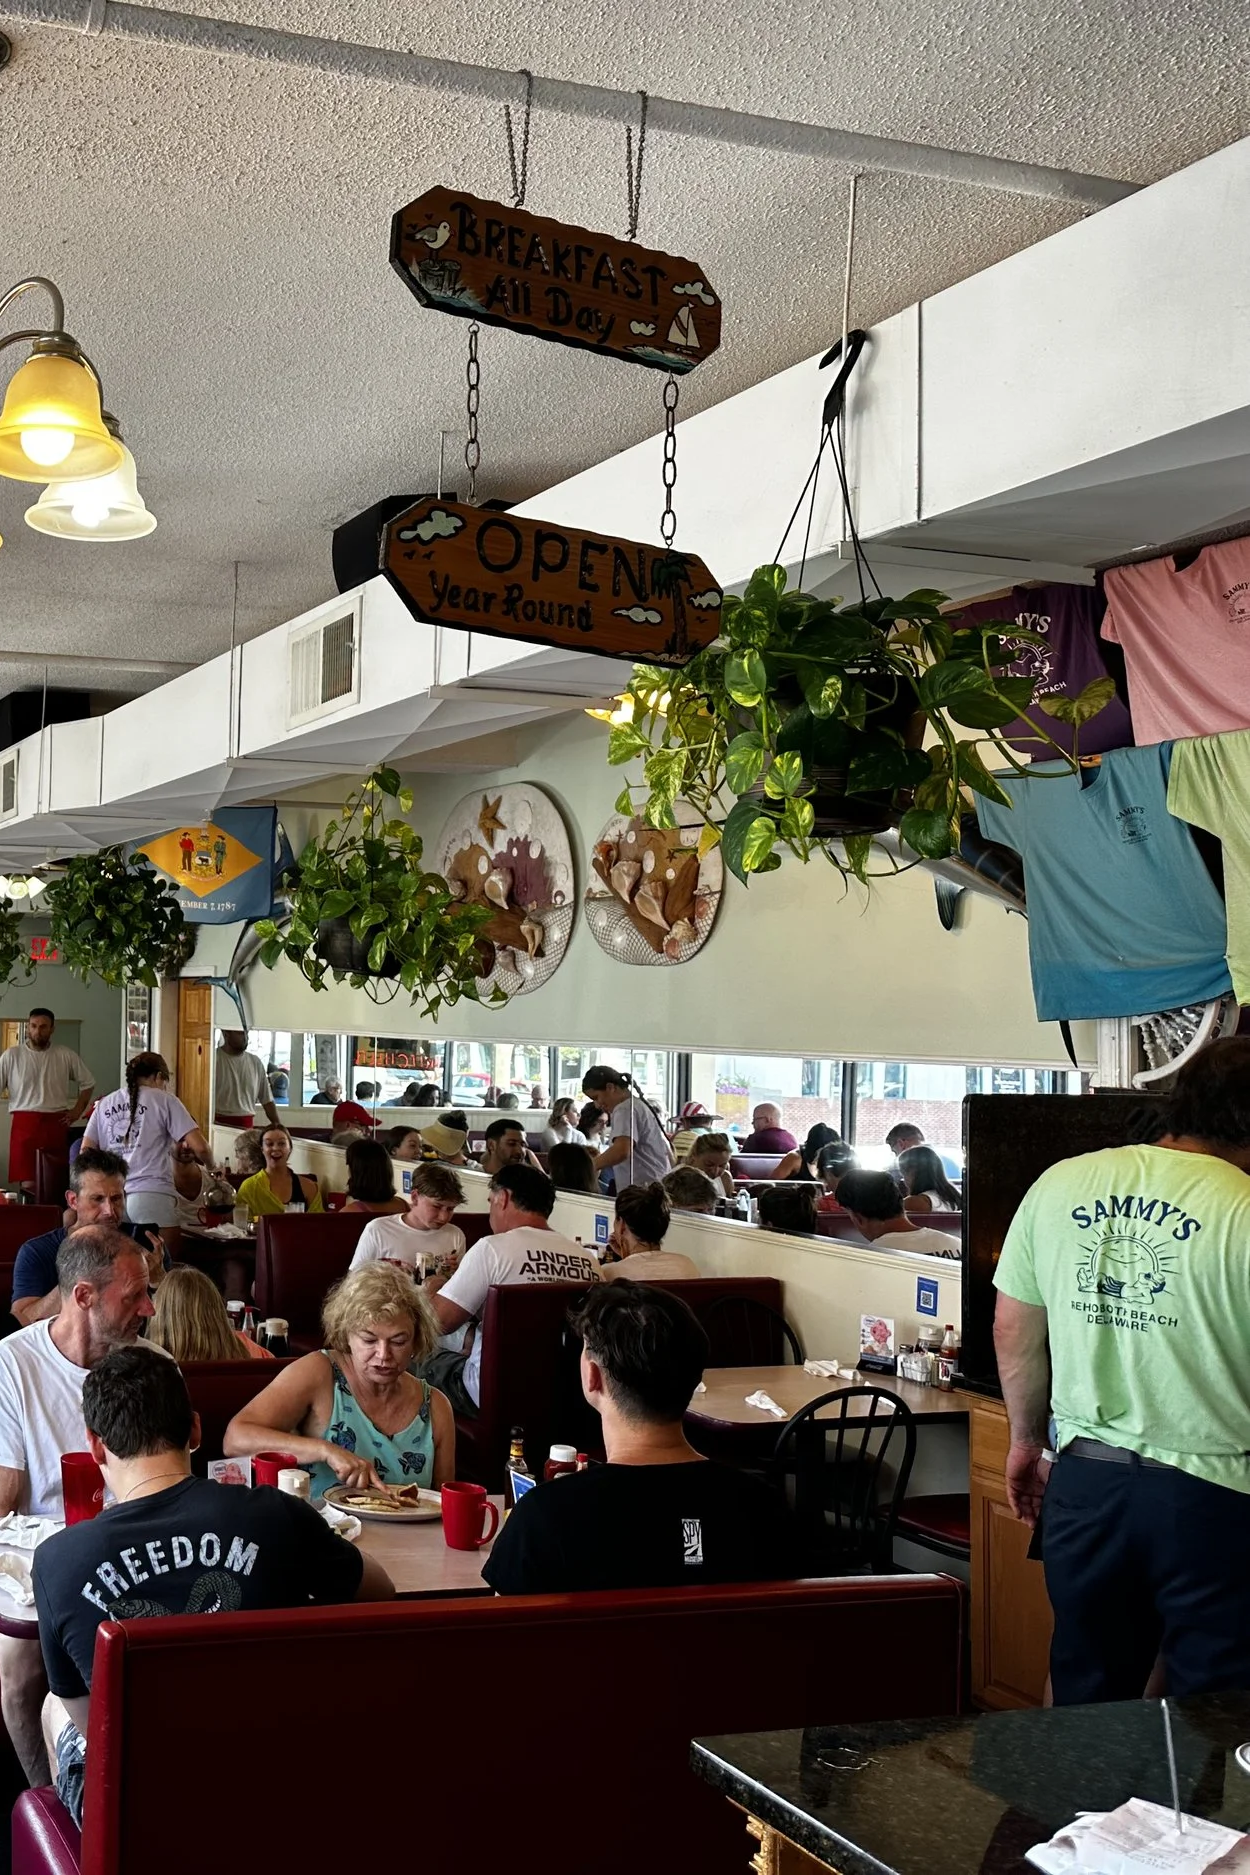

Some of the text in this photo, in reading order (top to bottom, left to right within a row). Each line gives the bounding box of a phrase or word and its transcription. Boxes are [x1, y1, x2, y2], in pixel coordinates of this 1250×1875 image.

[450, 203, 668, 306] BREAKFAST
[486, 275, 616, 344] All Day
[476, 518, 650, 602] OPEN
[429, 570, 594, 632] Year Round
[179, 900, 208, 910] EMBER
[1071, 1195, 1202, 1241] SAMMY'S
[519, 1262, 600, 1282] ARMOUR
[526, 1250, 593, 1270] UNDER
[1087, 1313, 1149, 1333] DELAWARE
[1130, 1310, 1179, 1328] BEACH
[683, 1521, 701, 1544] SPY
[81, 1532, 260, 1613] FREEDOM
